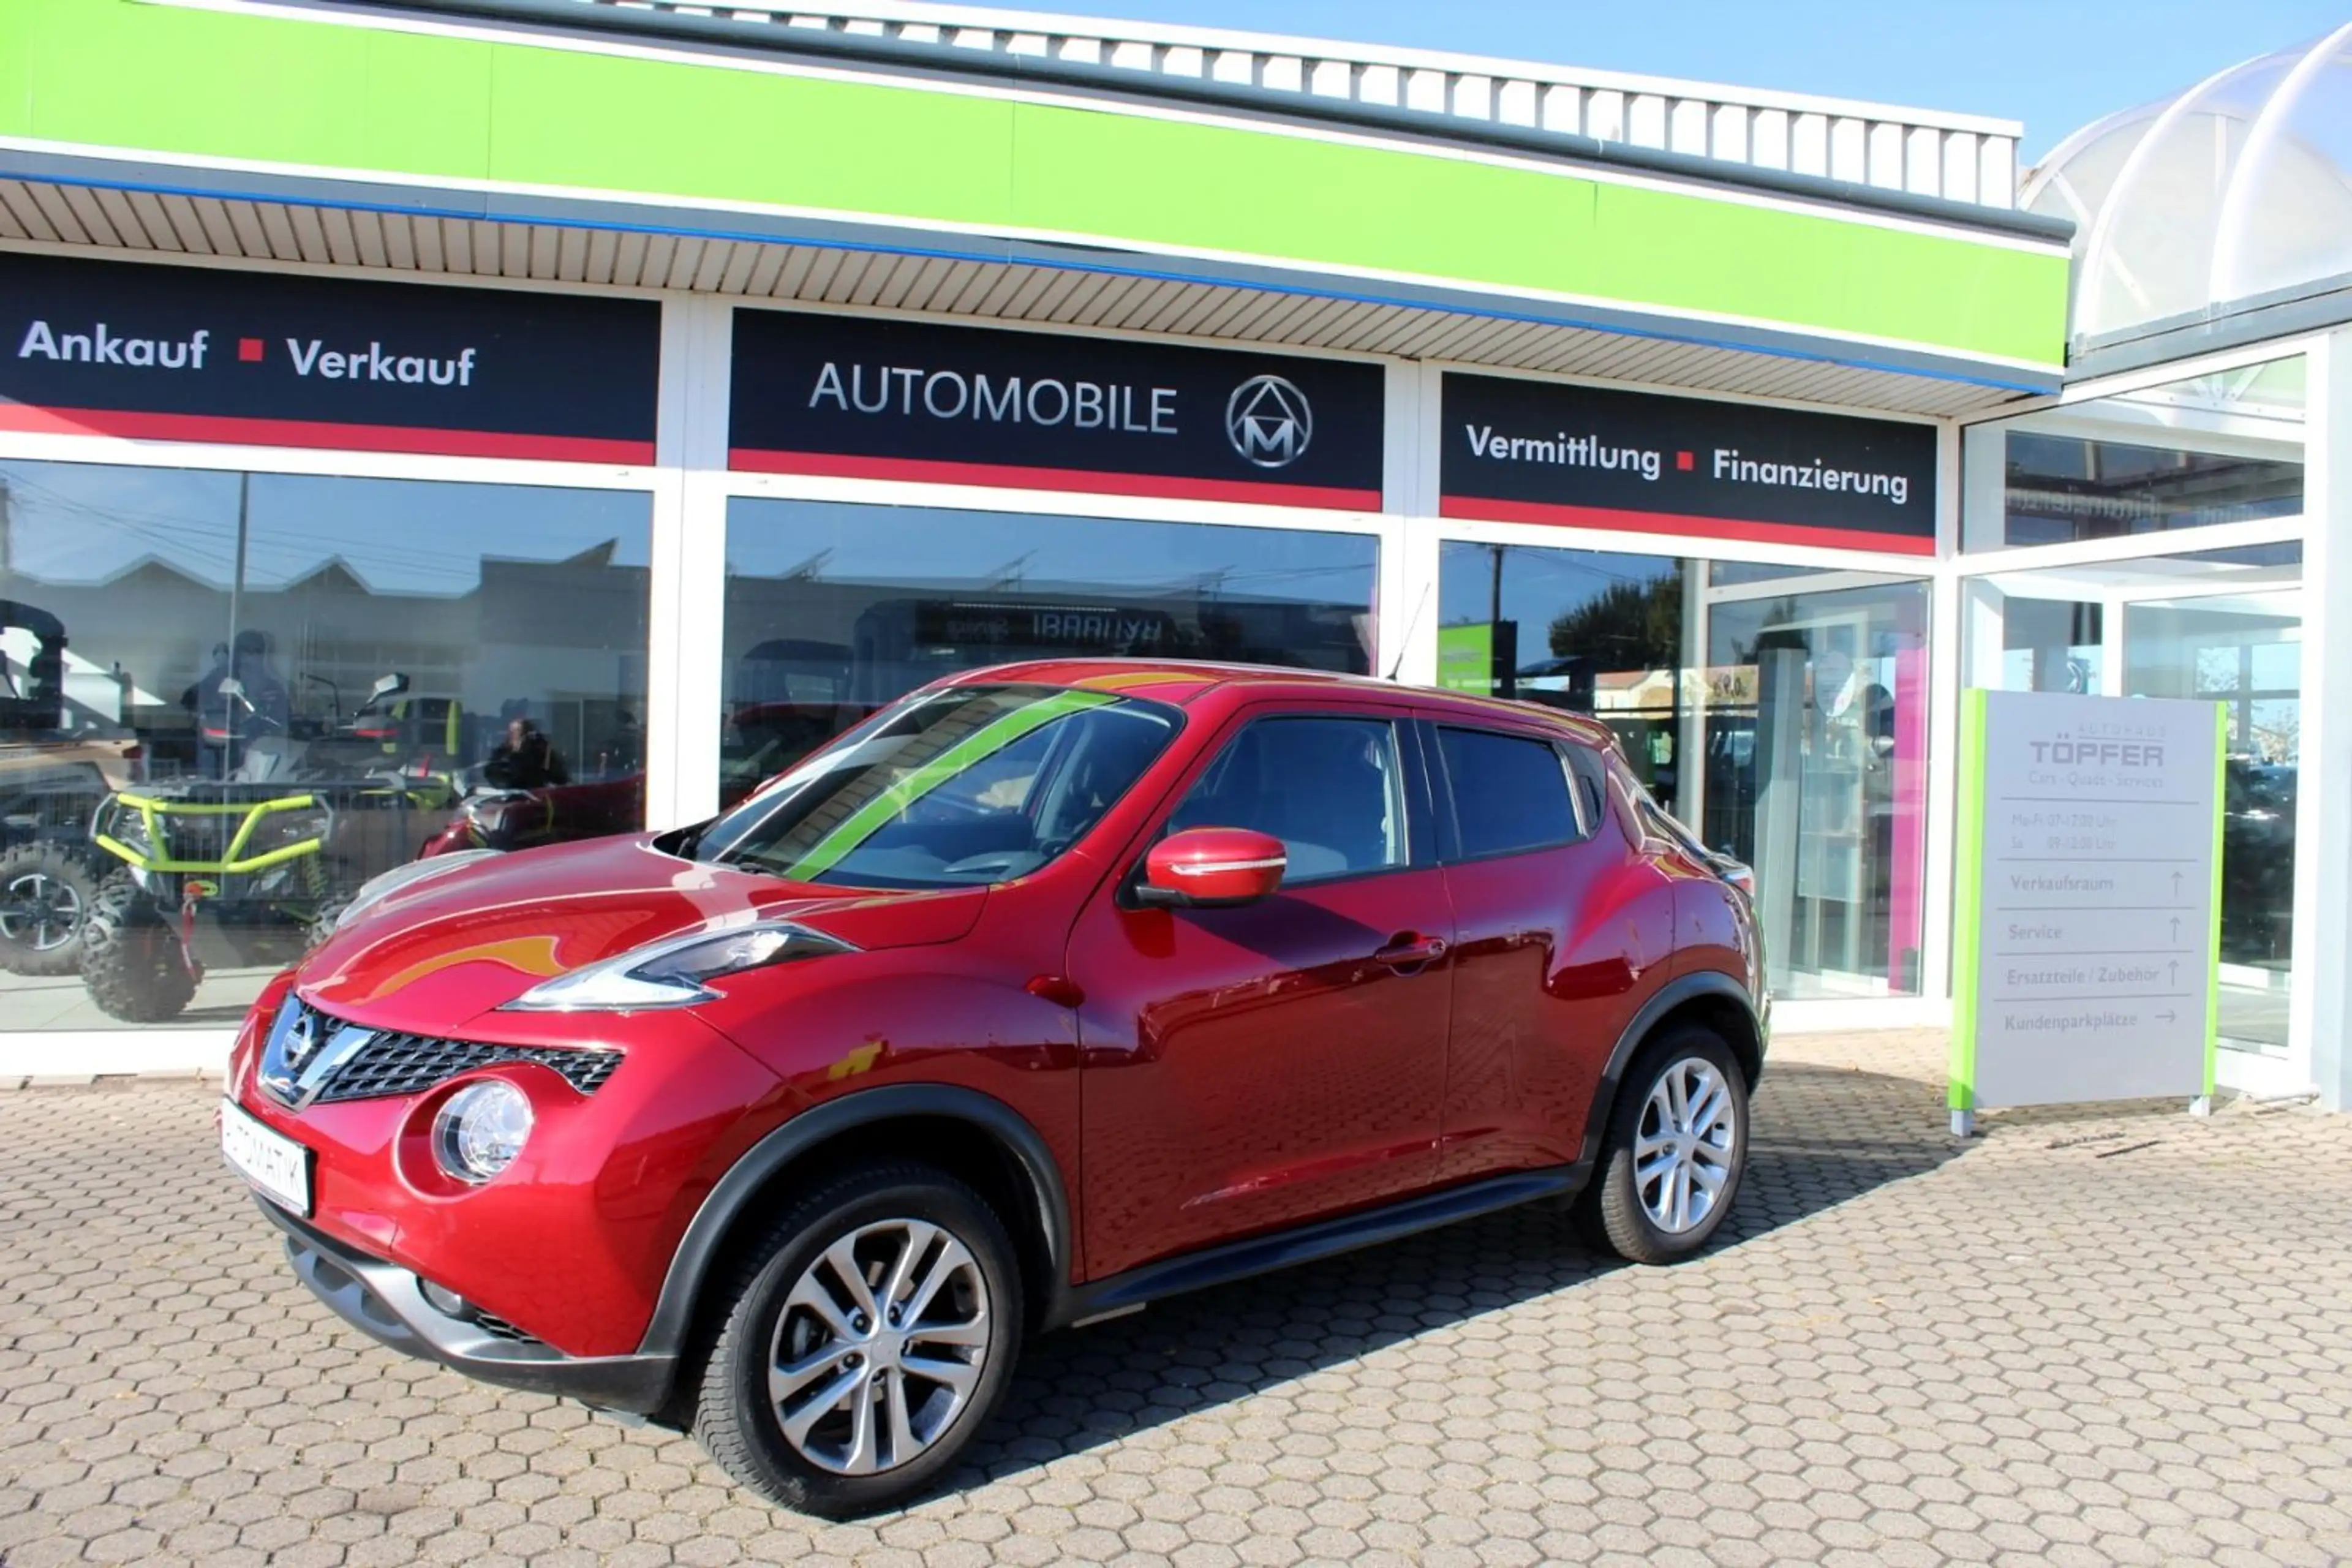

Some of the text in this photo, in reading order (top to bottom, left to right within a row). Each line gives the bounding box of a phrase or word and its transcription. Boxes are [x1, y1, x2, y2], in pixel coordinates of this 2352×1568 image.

[18, 320, 476, 386] Ankauf Verkauf
[809, 362, 1178, 434] AUTOMOBILE
[1466, 424, 1908, 505] Vermittlung Finanzierung
[2029, 732, 2165, 767] TÖPFER
[2010, 874, 2114, 891] Verkaufsraum
[2008, 924, 2063, 940] Service
[2007, 969, 2085, 986] Ersatzteile
